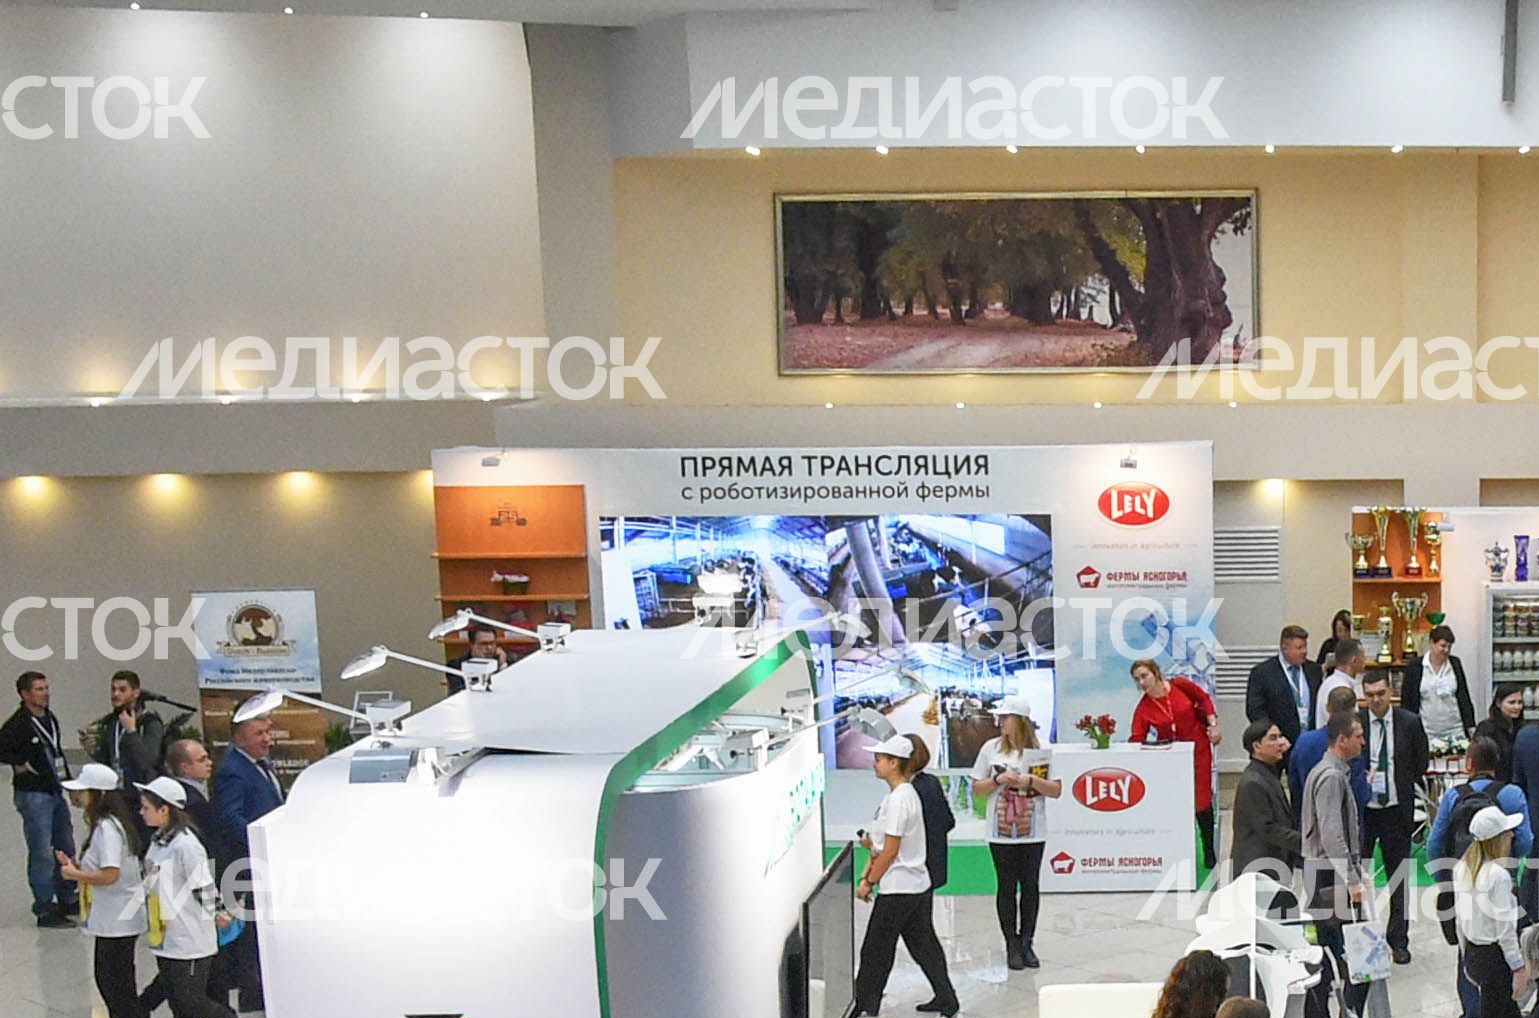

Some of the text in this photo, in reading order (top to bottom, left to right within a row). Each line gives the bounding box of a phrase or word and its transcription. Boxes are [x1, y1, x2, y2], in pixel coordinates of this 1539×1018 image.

[681, 454, 990, 479] ПРЯМАЯ ТРАНСЛЯЦИЯ
[700, 482, 909, 503] роботизированной
[916, 482, 990, 502] фермы
[1111, 488, 1157, 520] LELY
[1107, 571, 1187, 582] ФЕРМЫ ЯСНОГОРЬЯ
[1086, 775, 1132, 805] LELY
[1081, 857, 1162, 867] ФЕРМЫ ЯСНОГОРЬЯ
